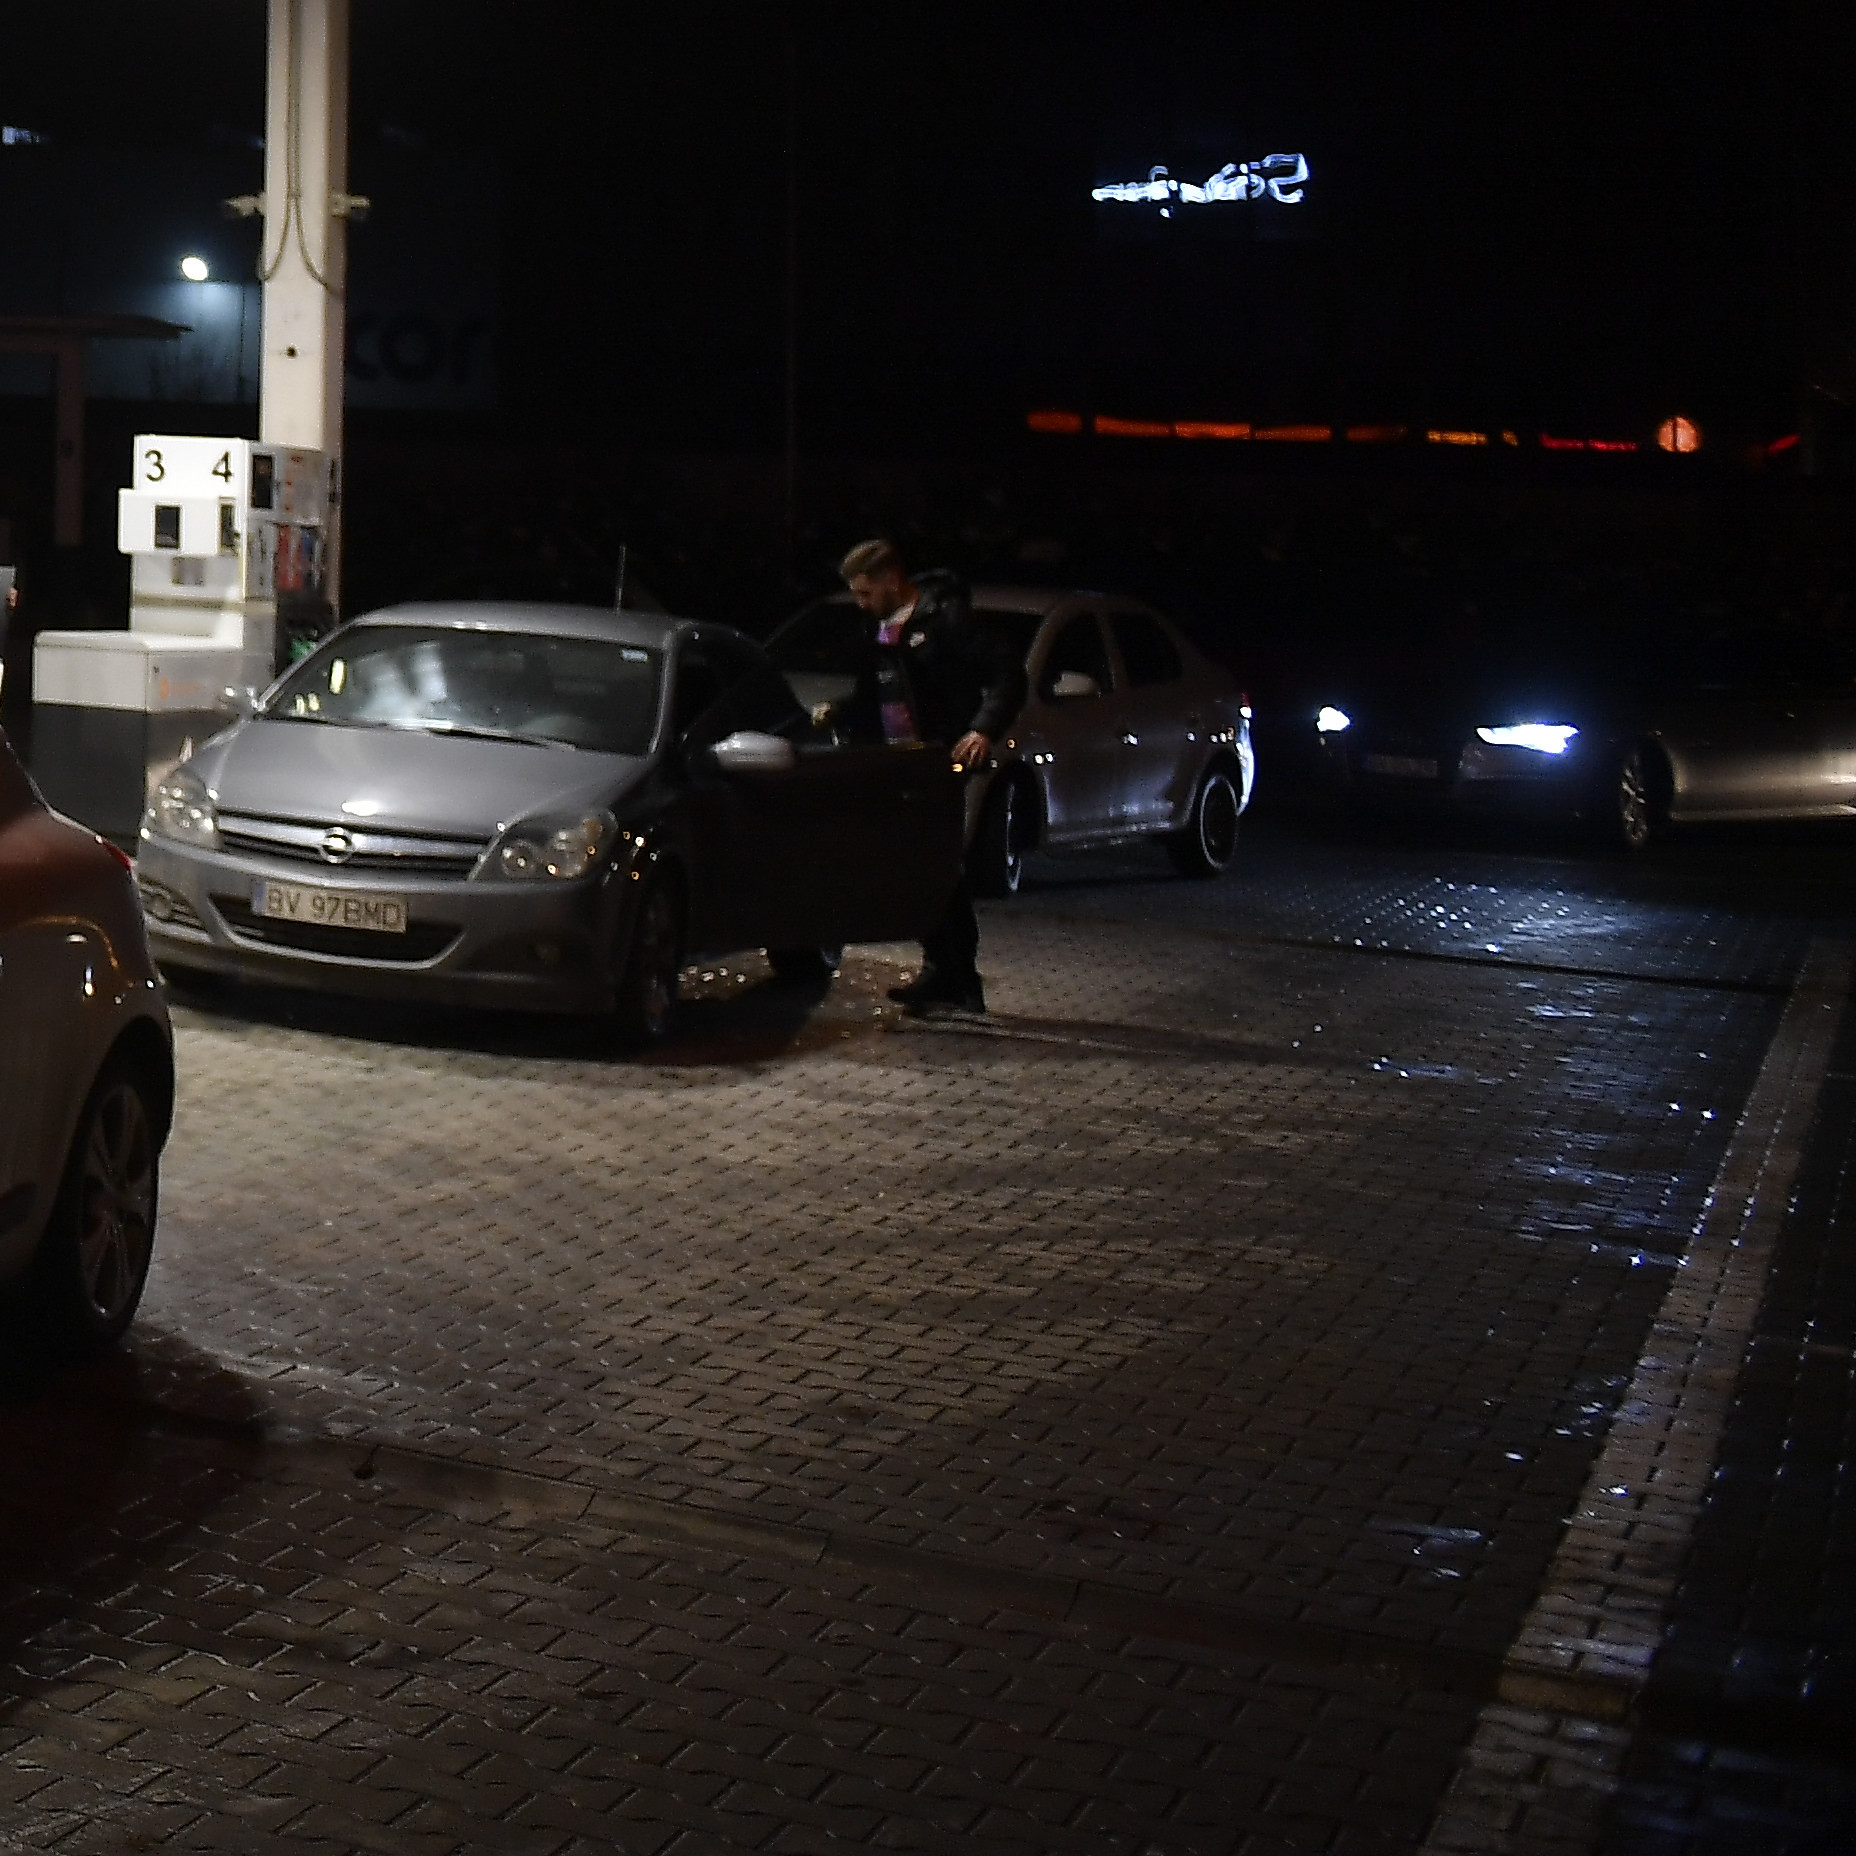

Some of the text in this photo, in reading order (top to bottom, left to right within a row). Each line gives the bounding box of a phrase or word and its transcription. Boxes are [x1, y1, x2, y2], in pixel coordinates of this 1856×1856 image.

[145, 449, 233, 483] 3 4
[267, 887, 300, 914] BV
